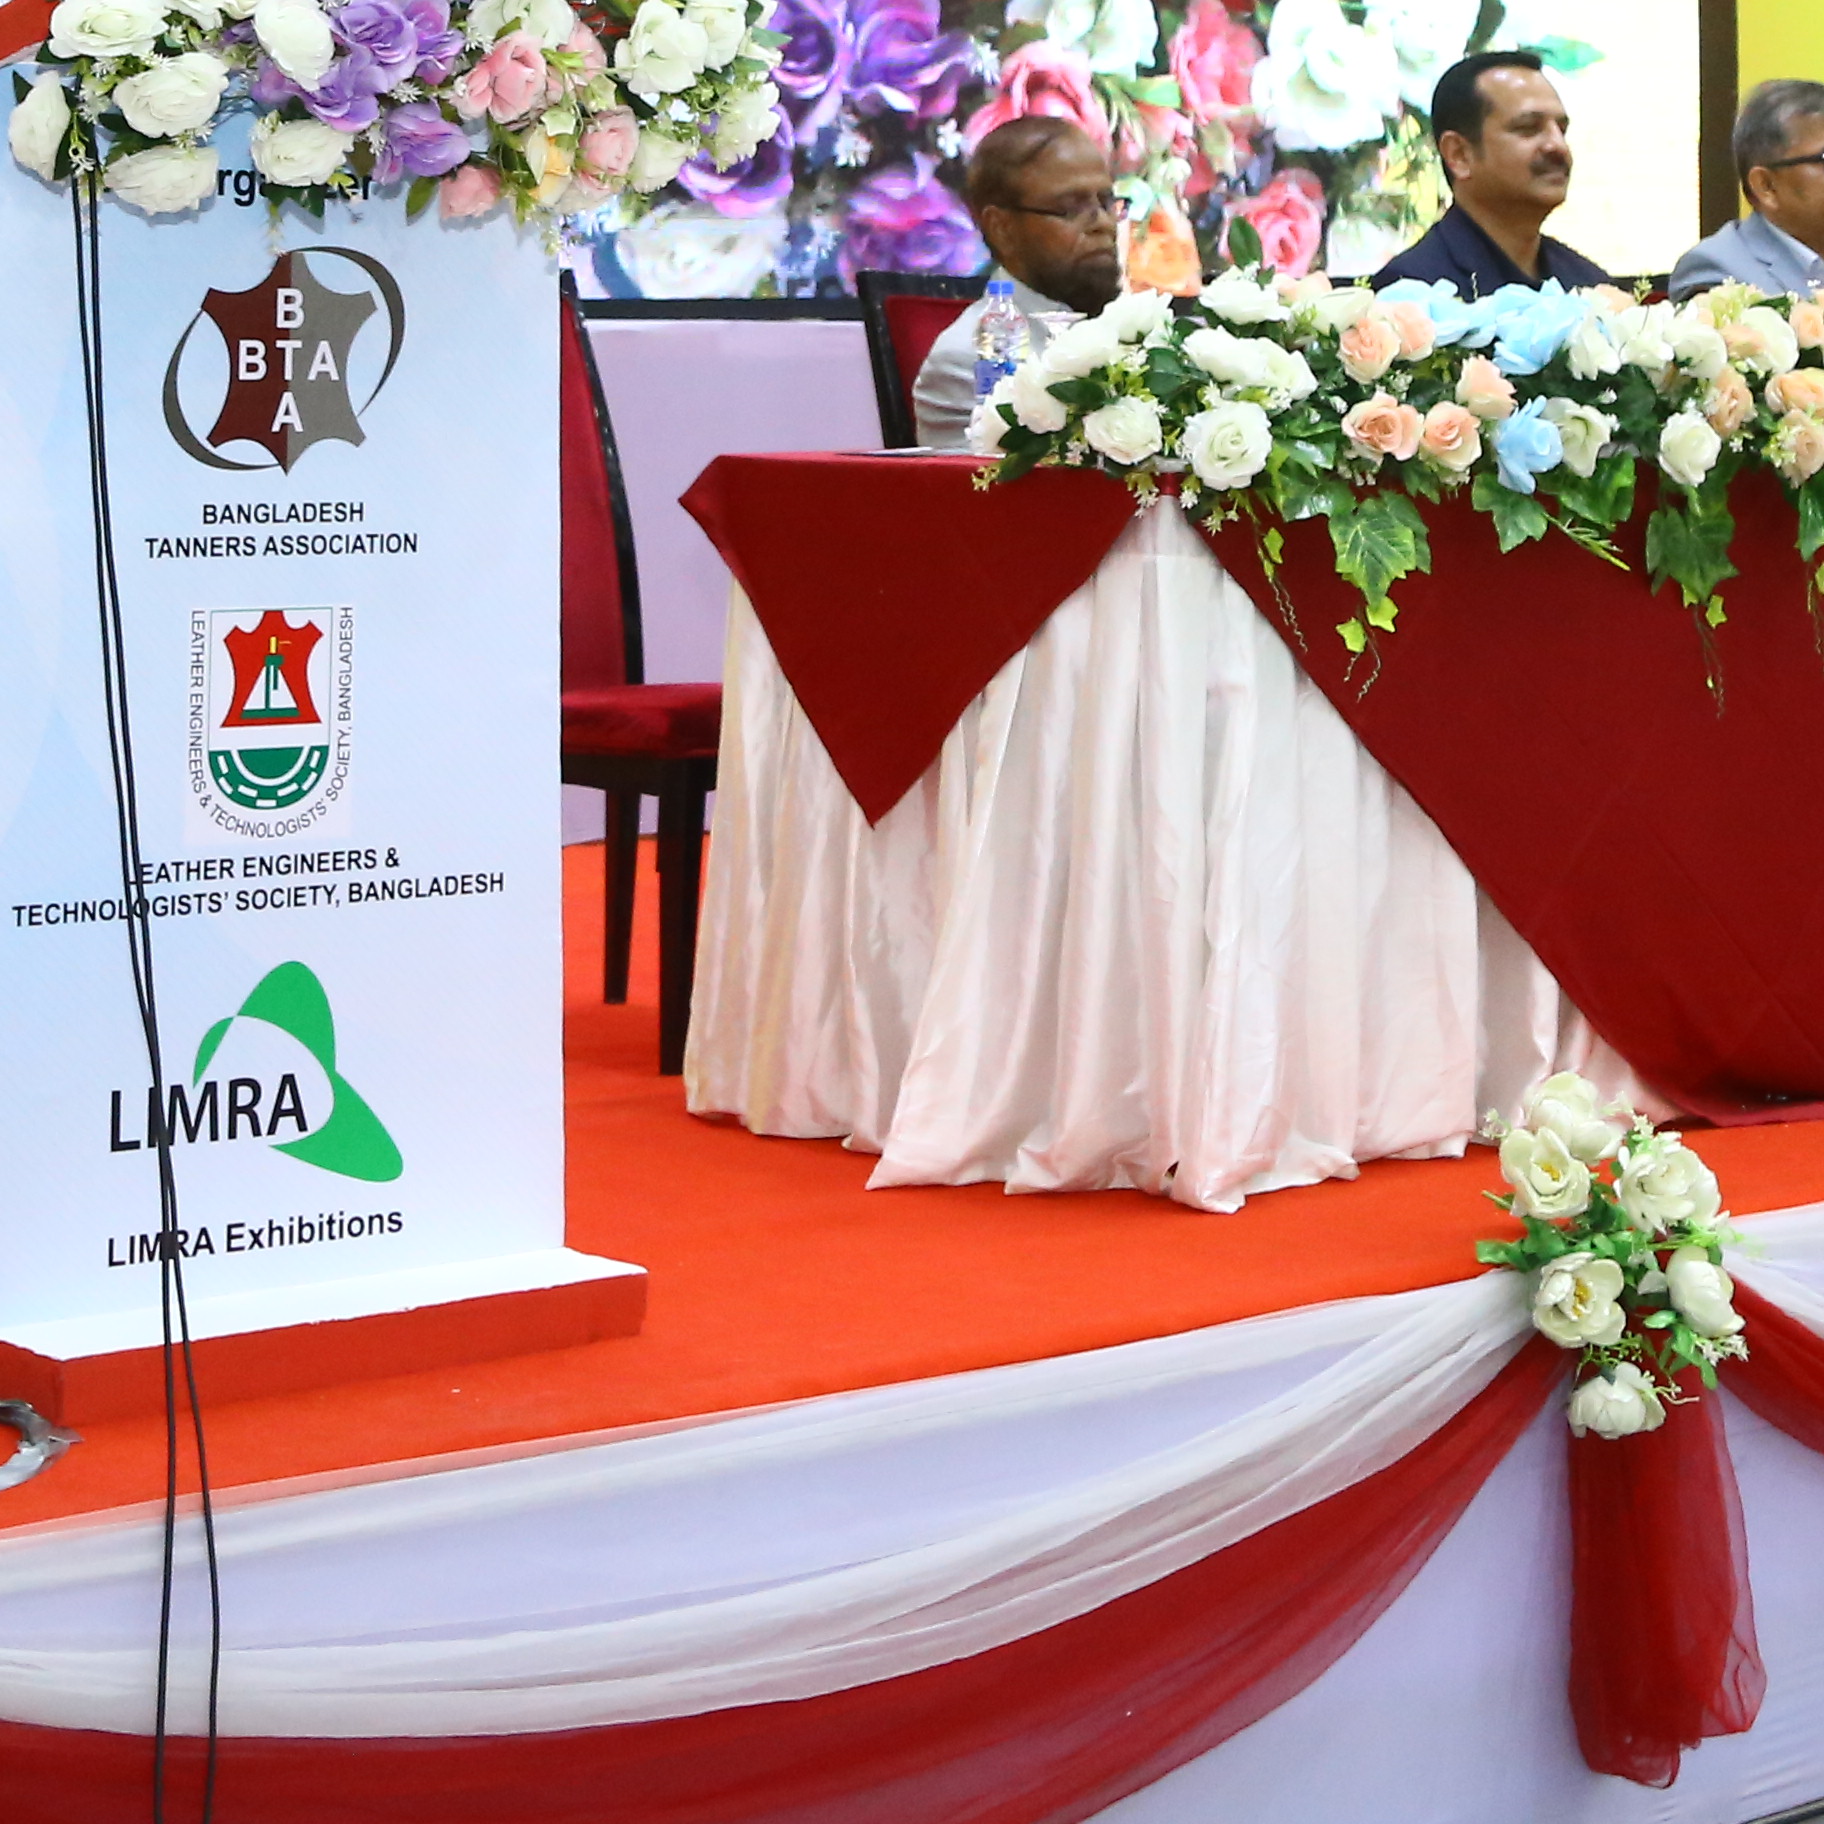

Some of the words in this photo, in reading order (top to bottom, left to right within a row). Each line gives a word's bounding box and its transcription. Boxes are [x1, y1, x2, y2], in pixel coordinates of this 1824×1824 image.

[202, 501, 365, 525] BANGLADESH
[144, 535, 257, 559] TANNERS
[261, 531, 419, 557] ASSOCIATION
[190, 609, 205, 690] LEATHER
[336, 606, 354, 722] BANGLADESH
[188, 692, 207, 795] ENGINEERS
[242, 848, 378, 877] ENGINEERS
[384, 847, 400, 869] &
[236, 882, 342, 911] SOCIETY,
[348, 871, 505, 904] BANGLADESH
[110, 1073, 309, 1152] LIMRA
[226, 1209, 404, 1253] Exhibitions
